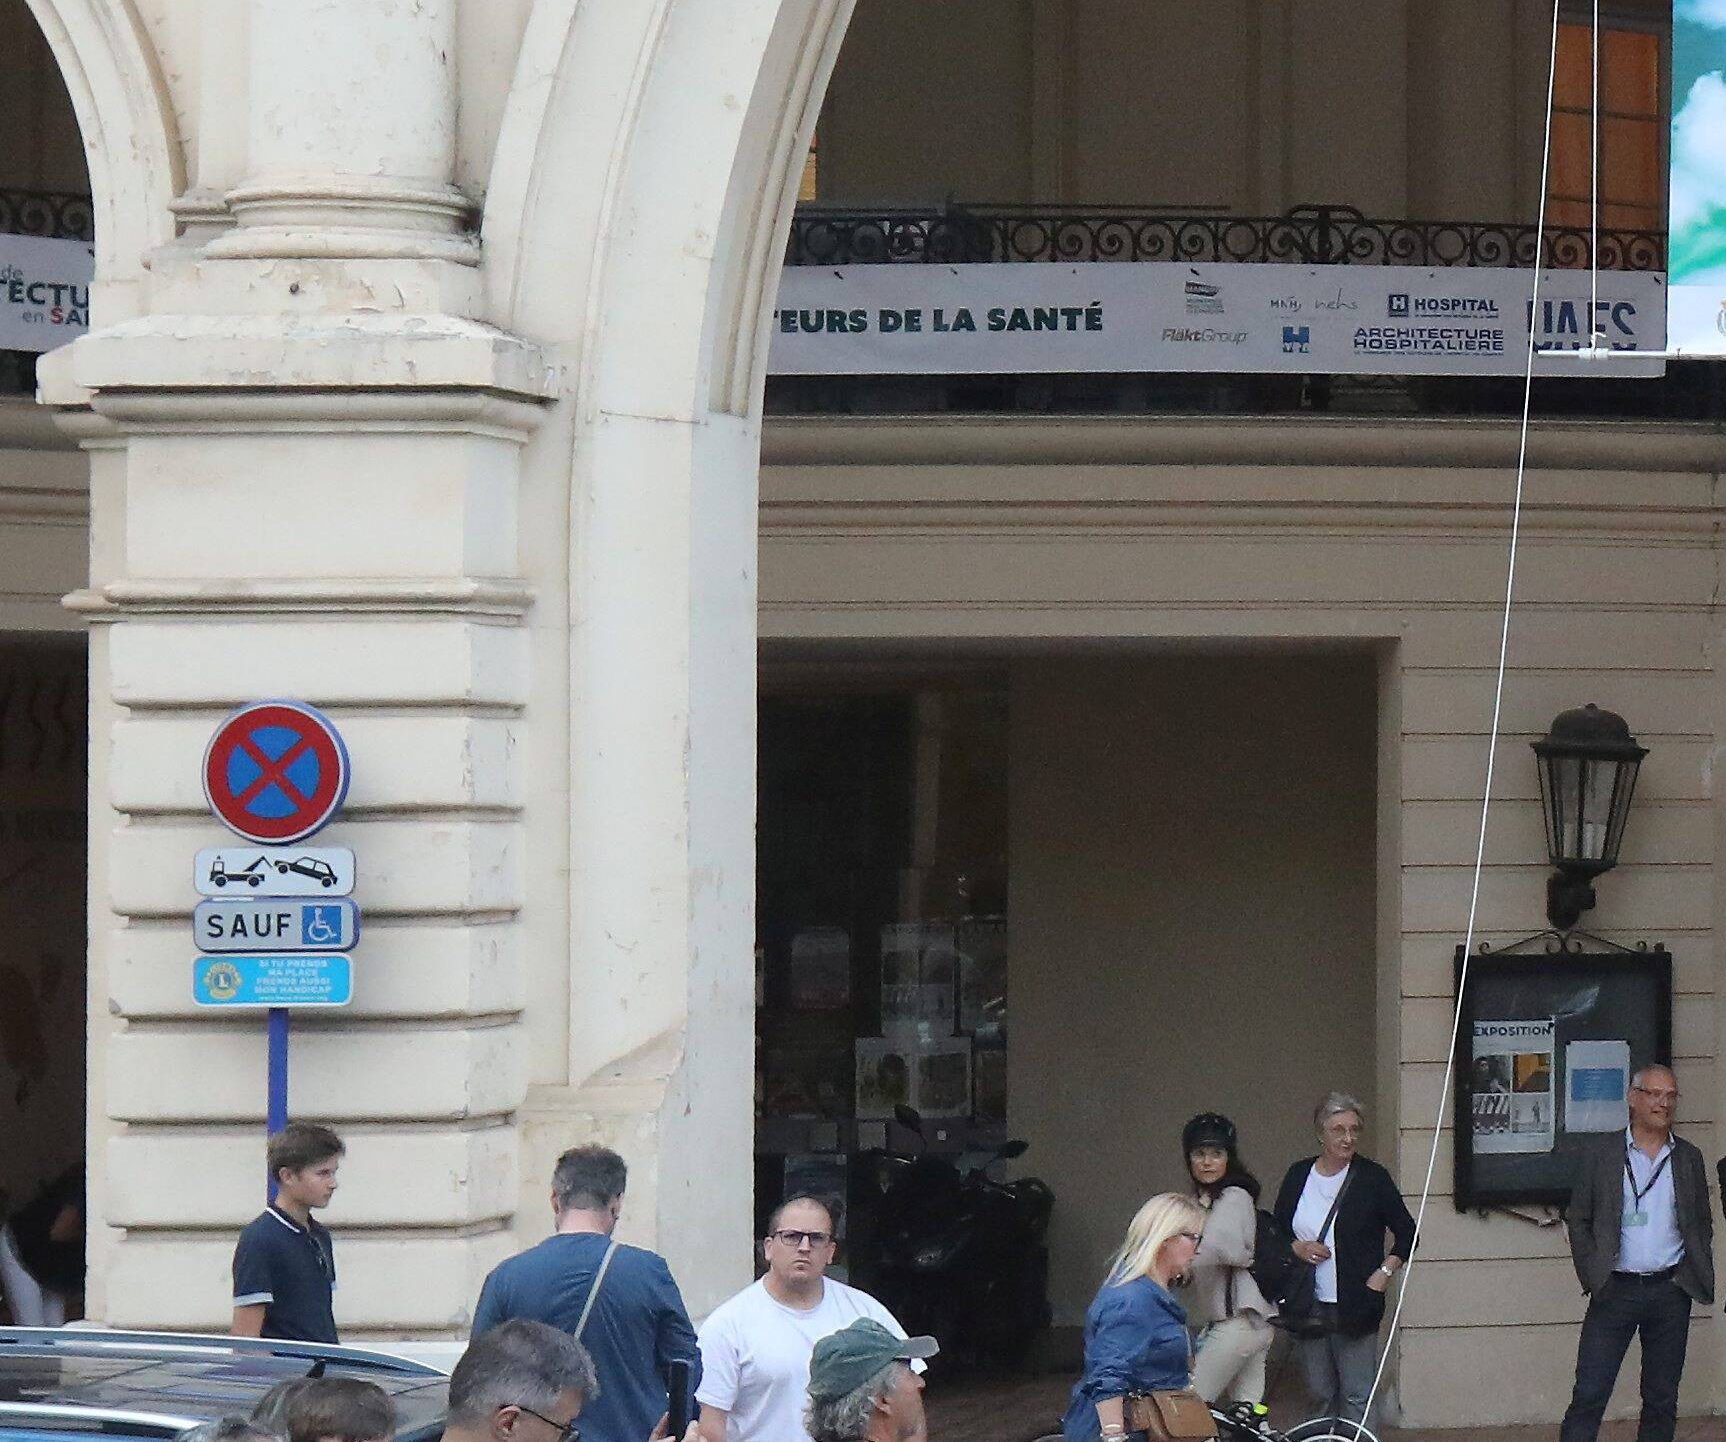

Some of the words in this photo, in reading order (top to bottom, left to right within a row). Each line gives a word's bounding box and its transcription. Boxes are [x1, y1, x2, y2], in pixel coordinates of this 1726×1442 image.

[1414, 298, 1499, 312] HOSPITAL
[774, 308, 867, 333] EURS
[879, 309, 921, 332] DE
[933, 308, 975, 332] LA
[987, 300, 1103, 332] SANTÉ
[1354, 327, 1504, 339] ARCHITECTURE
[207, 913, 291, 938] SAUF
[1473, 1025, 1551, 1037] EXPOSITION
